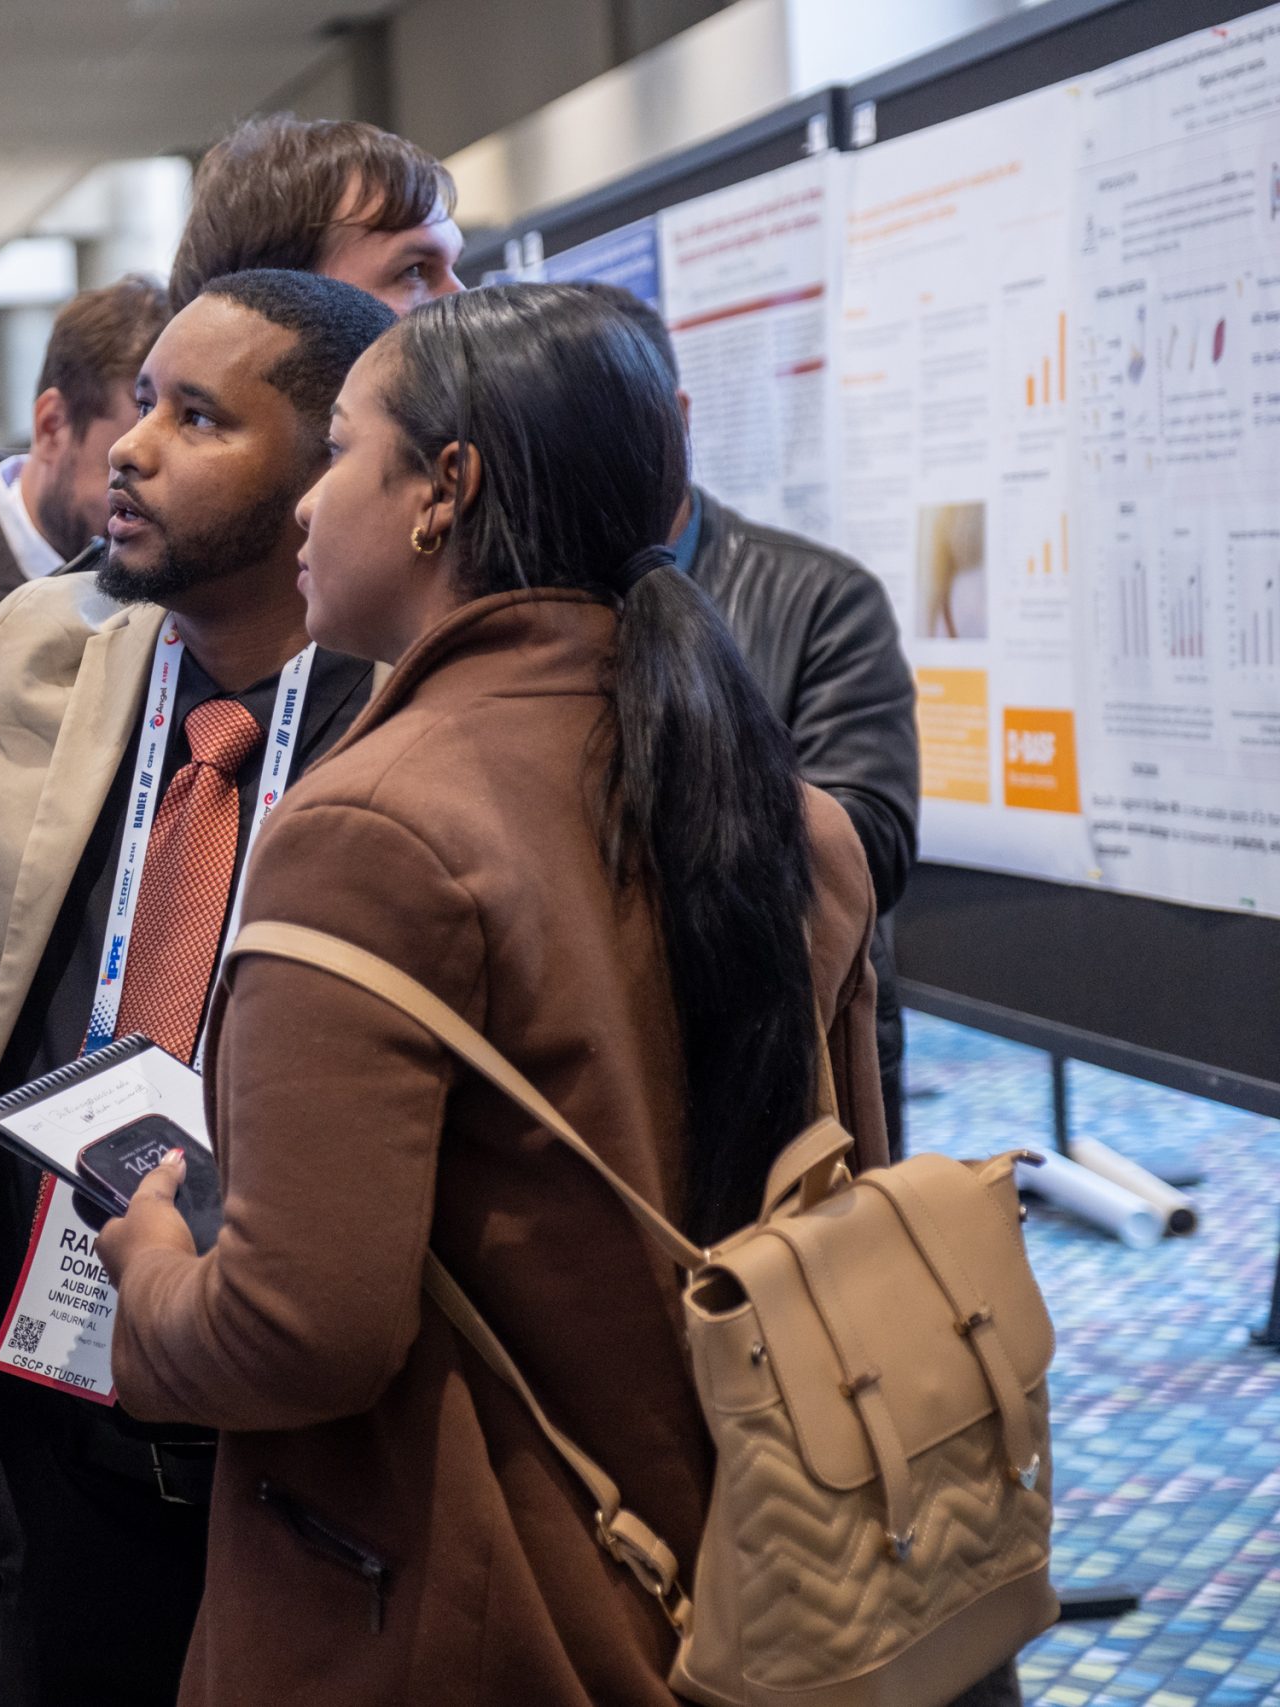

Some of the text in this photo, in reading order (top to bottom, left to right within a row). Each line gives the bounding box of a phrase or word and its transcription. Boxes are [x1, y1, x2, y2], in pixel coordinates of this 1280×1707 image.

[156, 687, 168, 714] Angel
[281, 688, 297, 726] BAADER
[133, 791, 149, 829] BAADER
[117, 842, 137, 915] KERRY A2141
[107, 934, 123, 979] IPPE
[59, 1228, 97, 1257] RA
[60, 1255, 111, 1286] DOME
[48, 1289, 112, 1318] UNIVERSITY
[61, 1278, 109, 1301] AUBURN
[86, 1321, 97, 1332] AL
[12, 1354, 97, 1389] CSCP STUDENT
